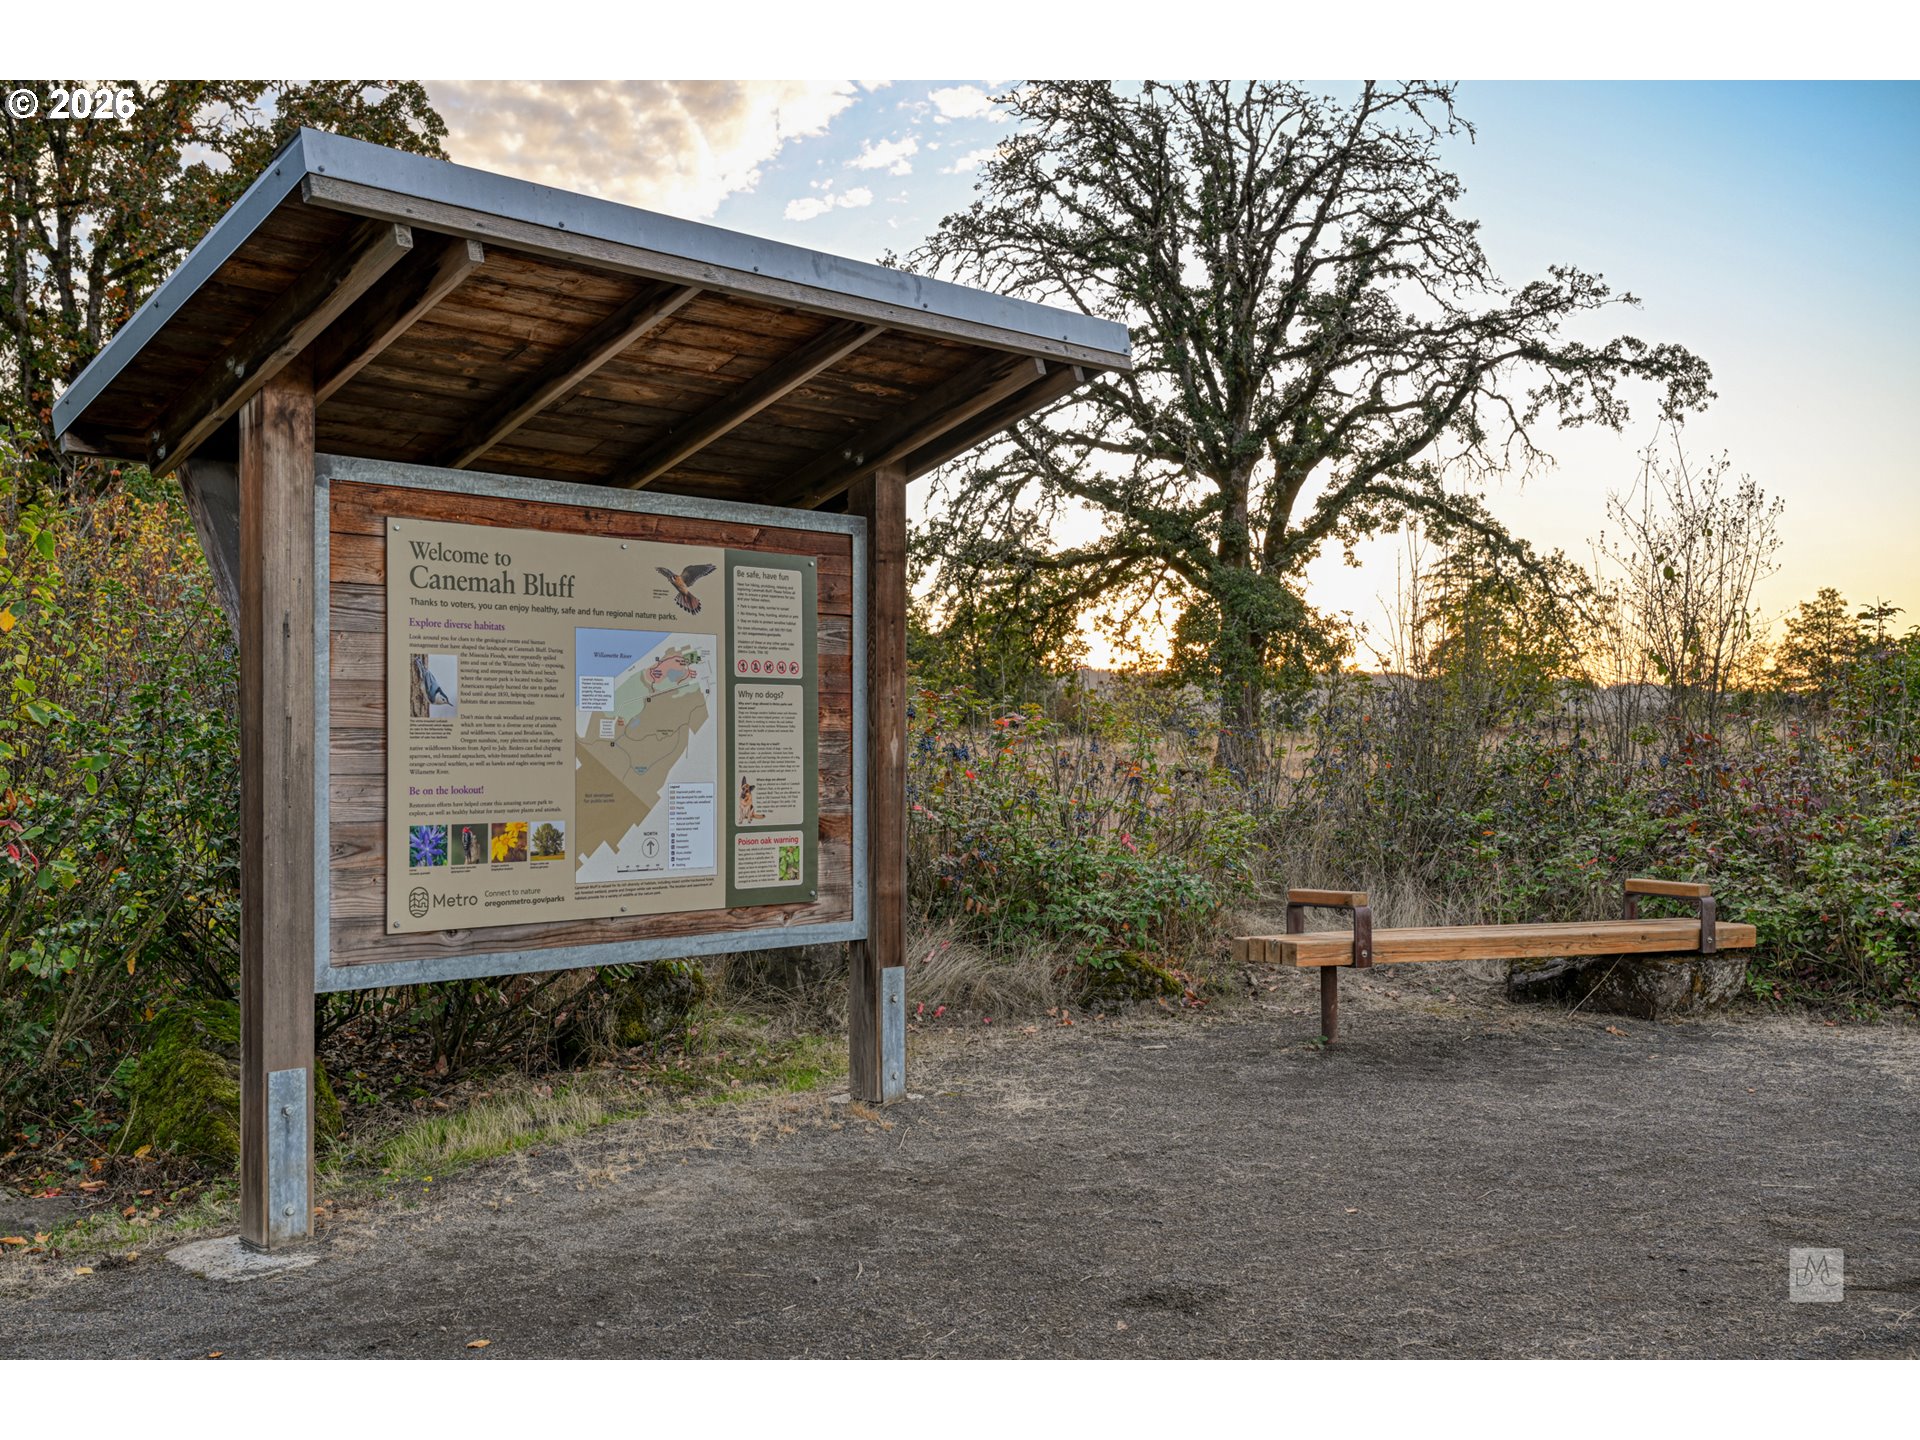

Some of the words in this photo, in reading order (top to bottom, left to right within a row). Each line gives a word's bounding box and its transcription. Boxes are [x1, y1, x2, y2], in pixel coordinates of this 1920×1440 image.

[409, 540, 488, 564] Welcome
[495, 551, 511, 566] to
[409, 565, 516, 594] Canemah
[523, 573, 575, 598] Bluff
[746, 571, 760, 579] safe,
[763, 572, 777, 580] have
[410, 598, 437, 607] Thanks
[510, 604, 529, 613] enjoy
[532, 604, 559, 614] healthy,
[606, 610, 633, 618] regional
[409, 618, 441, 628] Explore
[444, 619, 472, 629] diverse
[474, 621, 505, 631] habitats
[738, 690, 753, 699] Why
[765, 691, 784, 700] dogs?
[409, 787, 420, 795] Be
[436, 786, 448, 794] the
[451, 786, 484, 794] lookout!
[433, 894, 478, 908] Metro
[485, 896, 565, 907] oregonmetro.gov/parks
